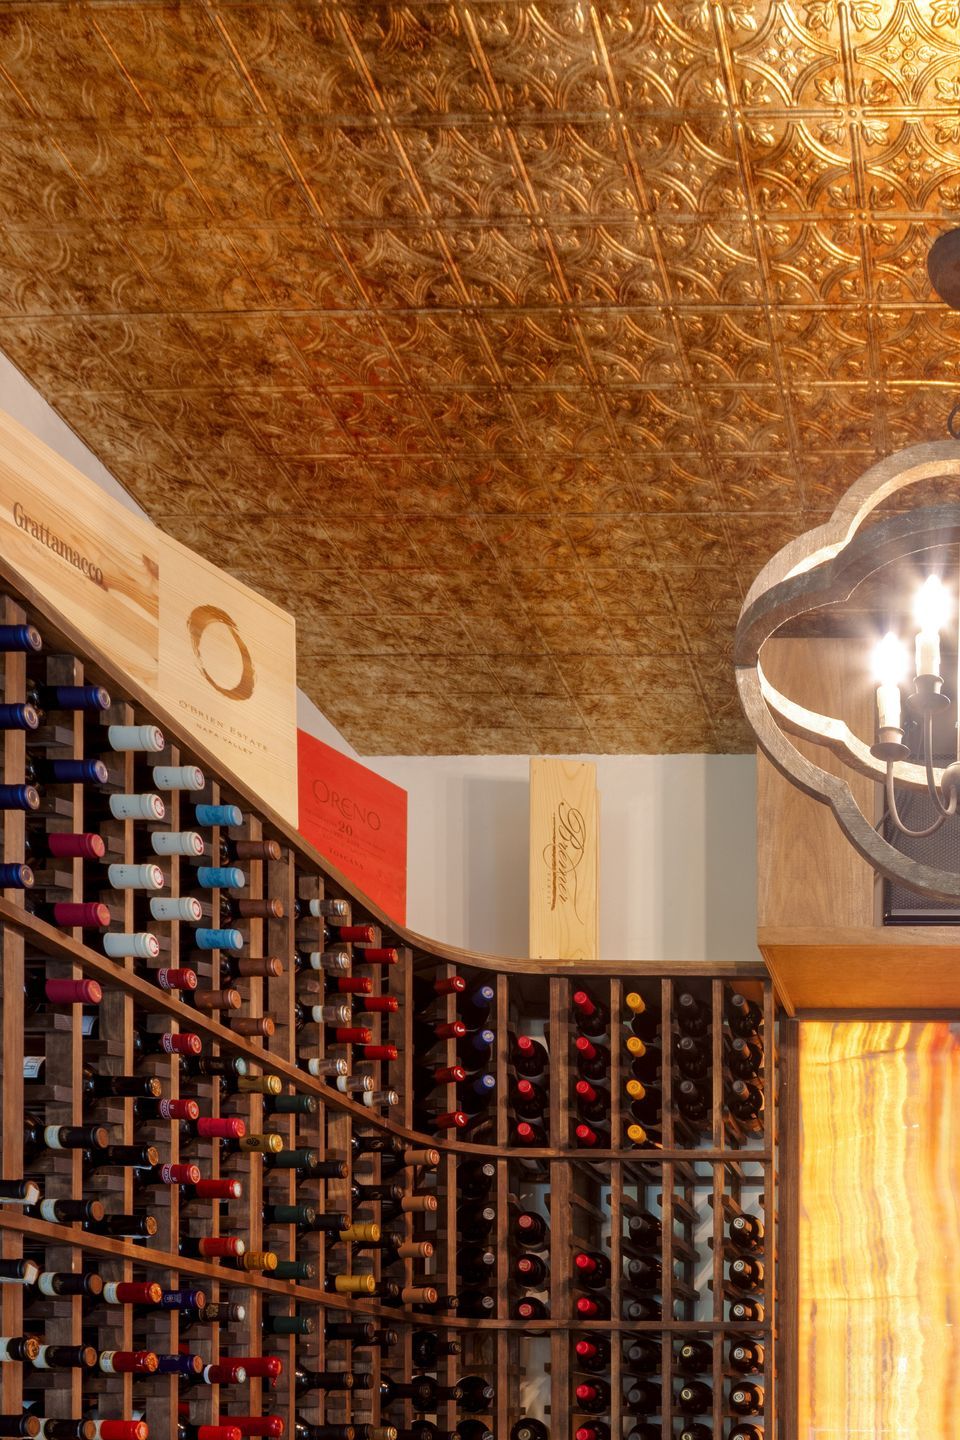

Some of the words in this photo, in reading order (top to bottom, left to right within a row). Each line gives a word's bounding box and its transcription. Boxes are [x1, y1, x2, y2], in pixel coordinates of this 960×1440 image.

[13, 501, 104, 585] Grattamacco
[179, 699, 224, 728] O'BRIEN
[229, 726, 267, 751] ESTATE
[196, 723, 219, 738] NAPA
[222, 735, 254, 755] VALLEY
